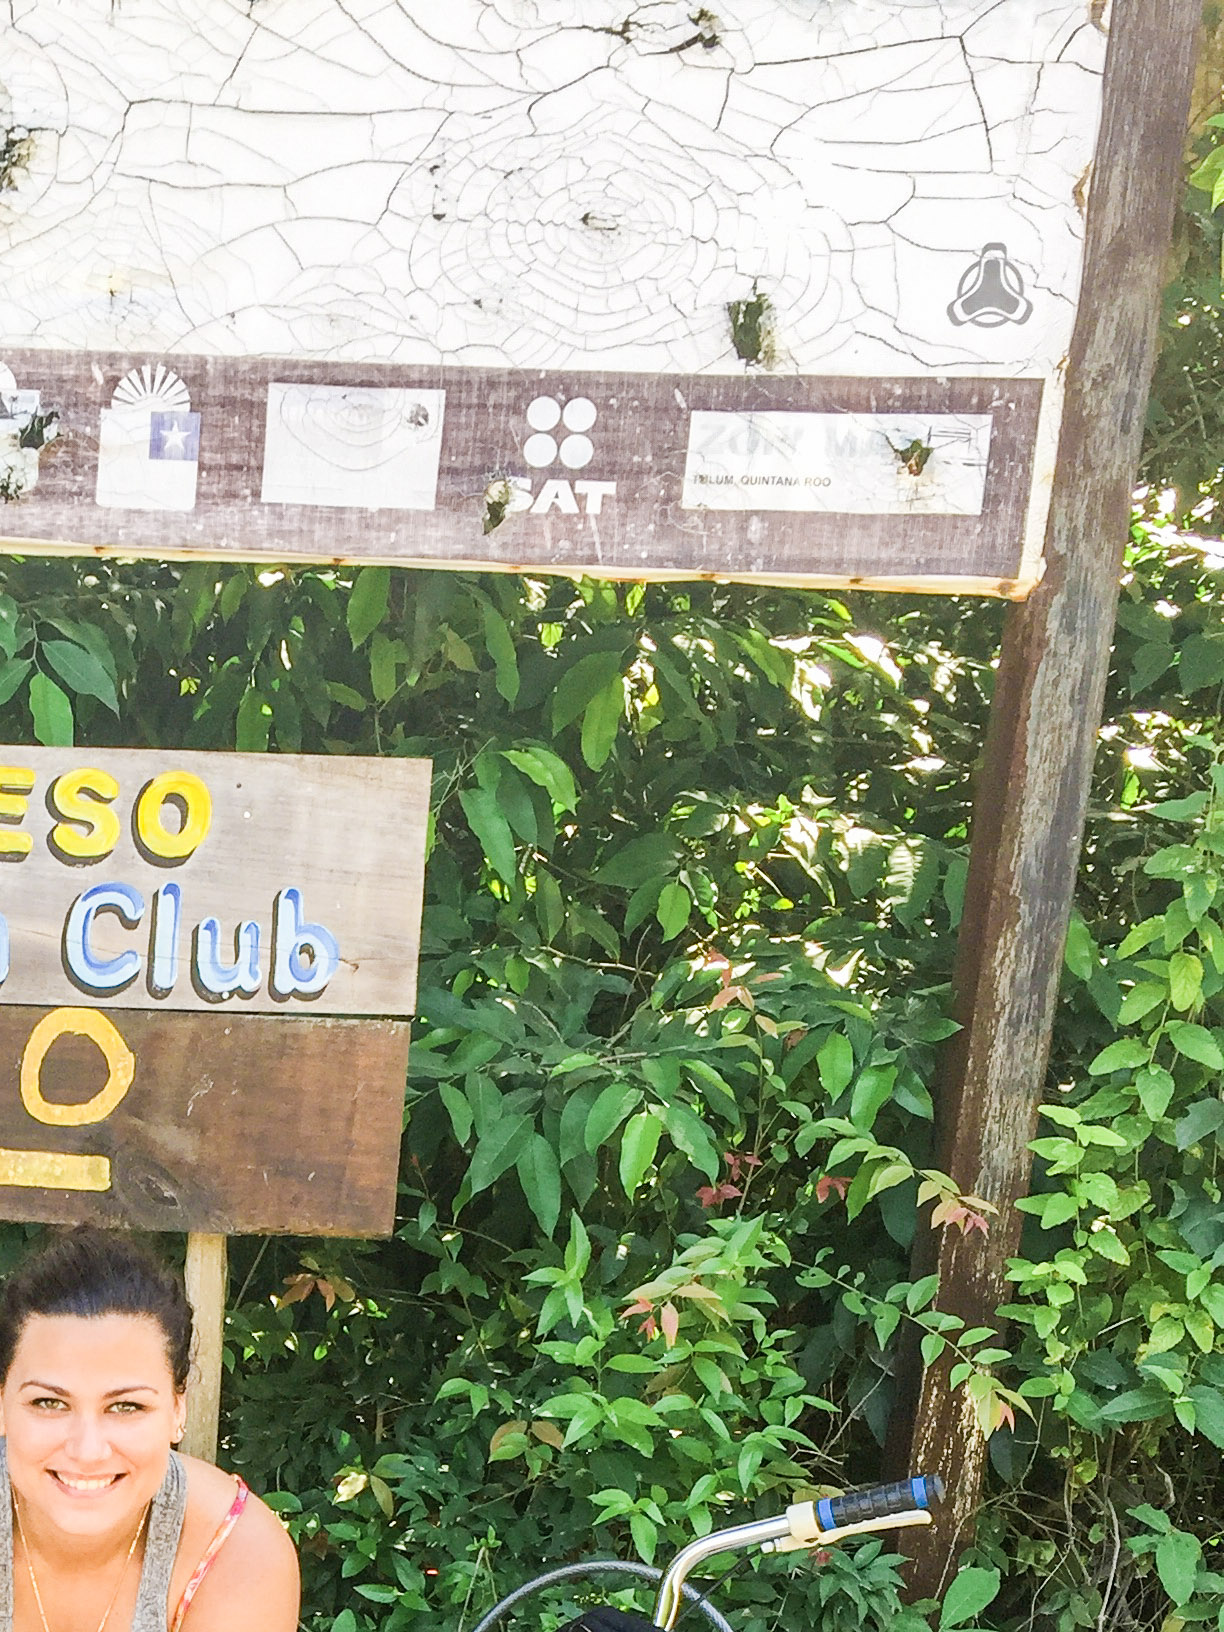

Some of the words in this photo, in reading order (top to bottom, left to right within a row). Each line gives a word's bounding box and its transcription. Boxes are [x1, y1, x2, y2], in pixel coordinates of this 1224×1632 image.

[504, 476, 617, 515] SAT
[740, 474, 801, 487] QUINTANA
[804, 476, 832, 488] ROO
[63, 880, 341, 1001] Club
